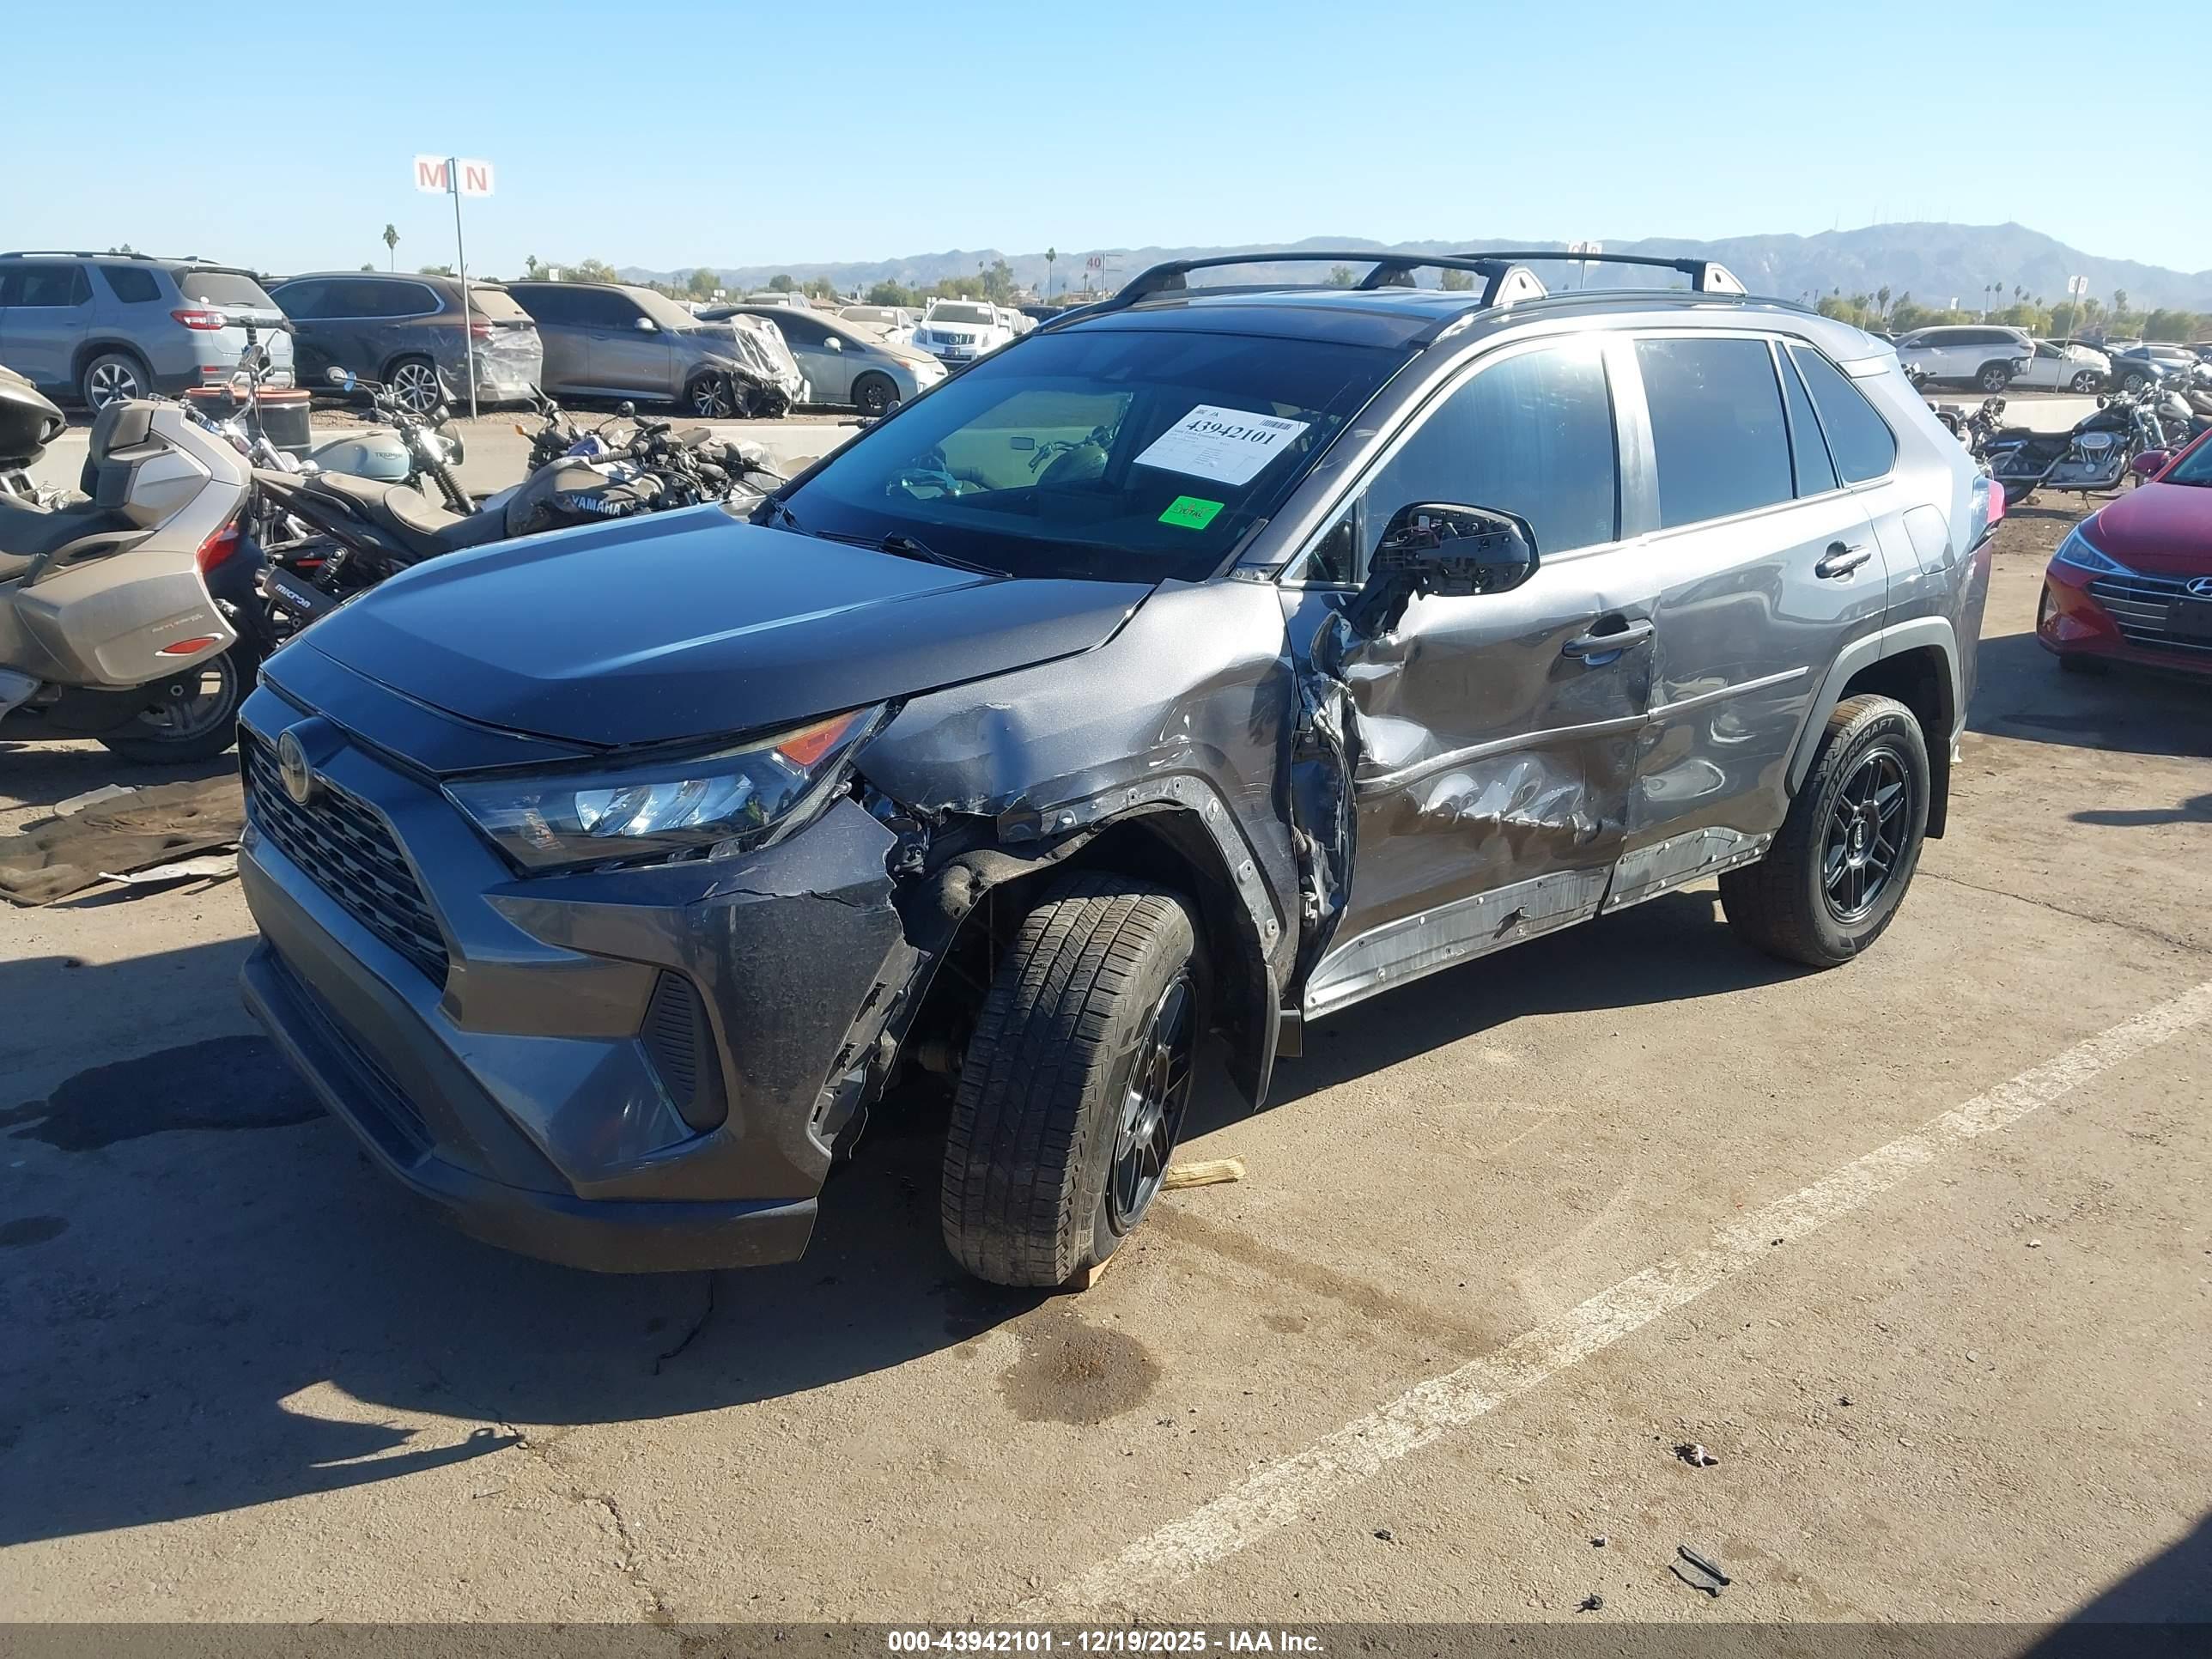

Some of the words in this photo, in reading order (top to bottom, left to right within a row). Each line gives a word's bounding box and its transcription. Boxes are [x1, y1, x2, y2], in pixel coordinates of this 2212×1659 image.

[419, 162, 447, 187] M
[467, 167, 487, 191] N
[1087, 257, 1101, 268] 40
[1187, 419, 1278, 446] 43942101
[571, 495, 621, 515] YAMAHA
